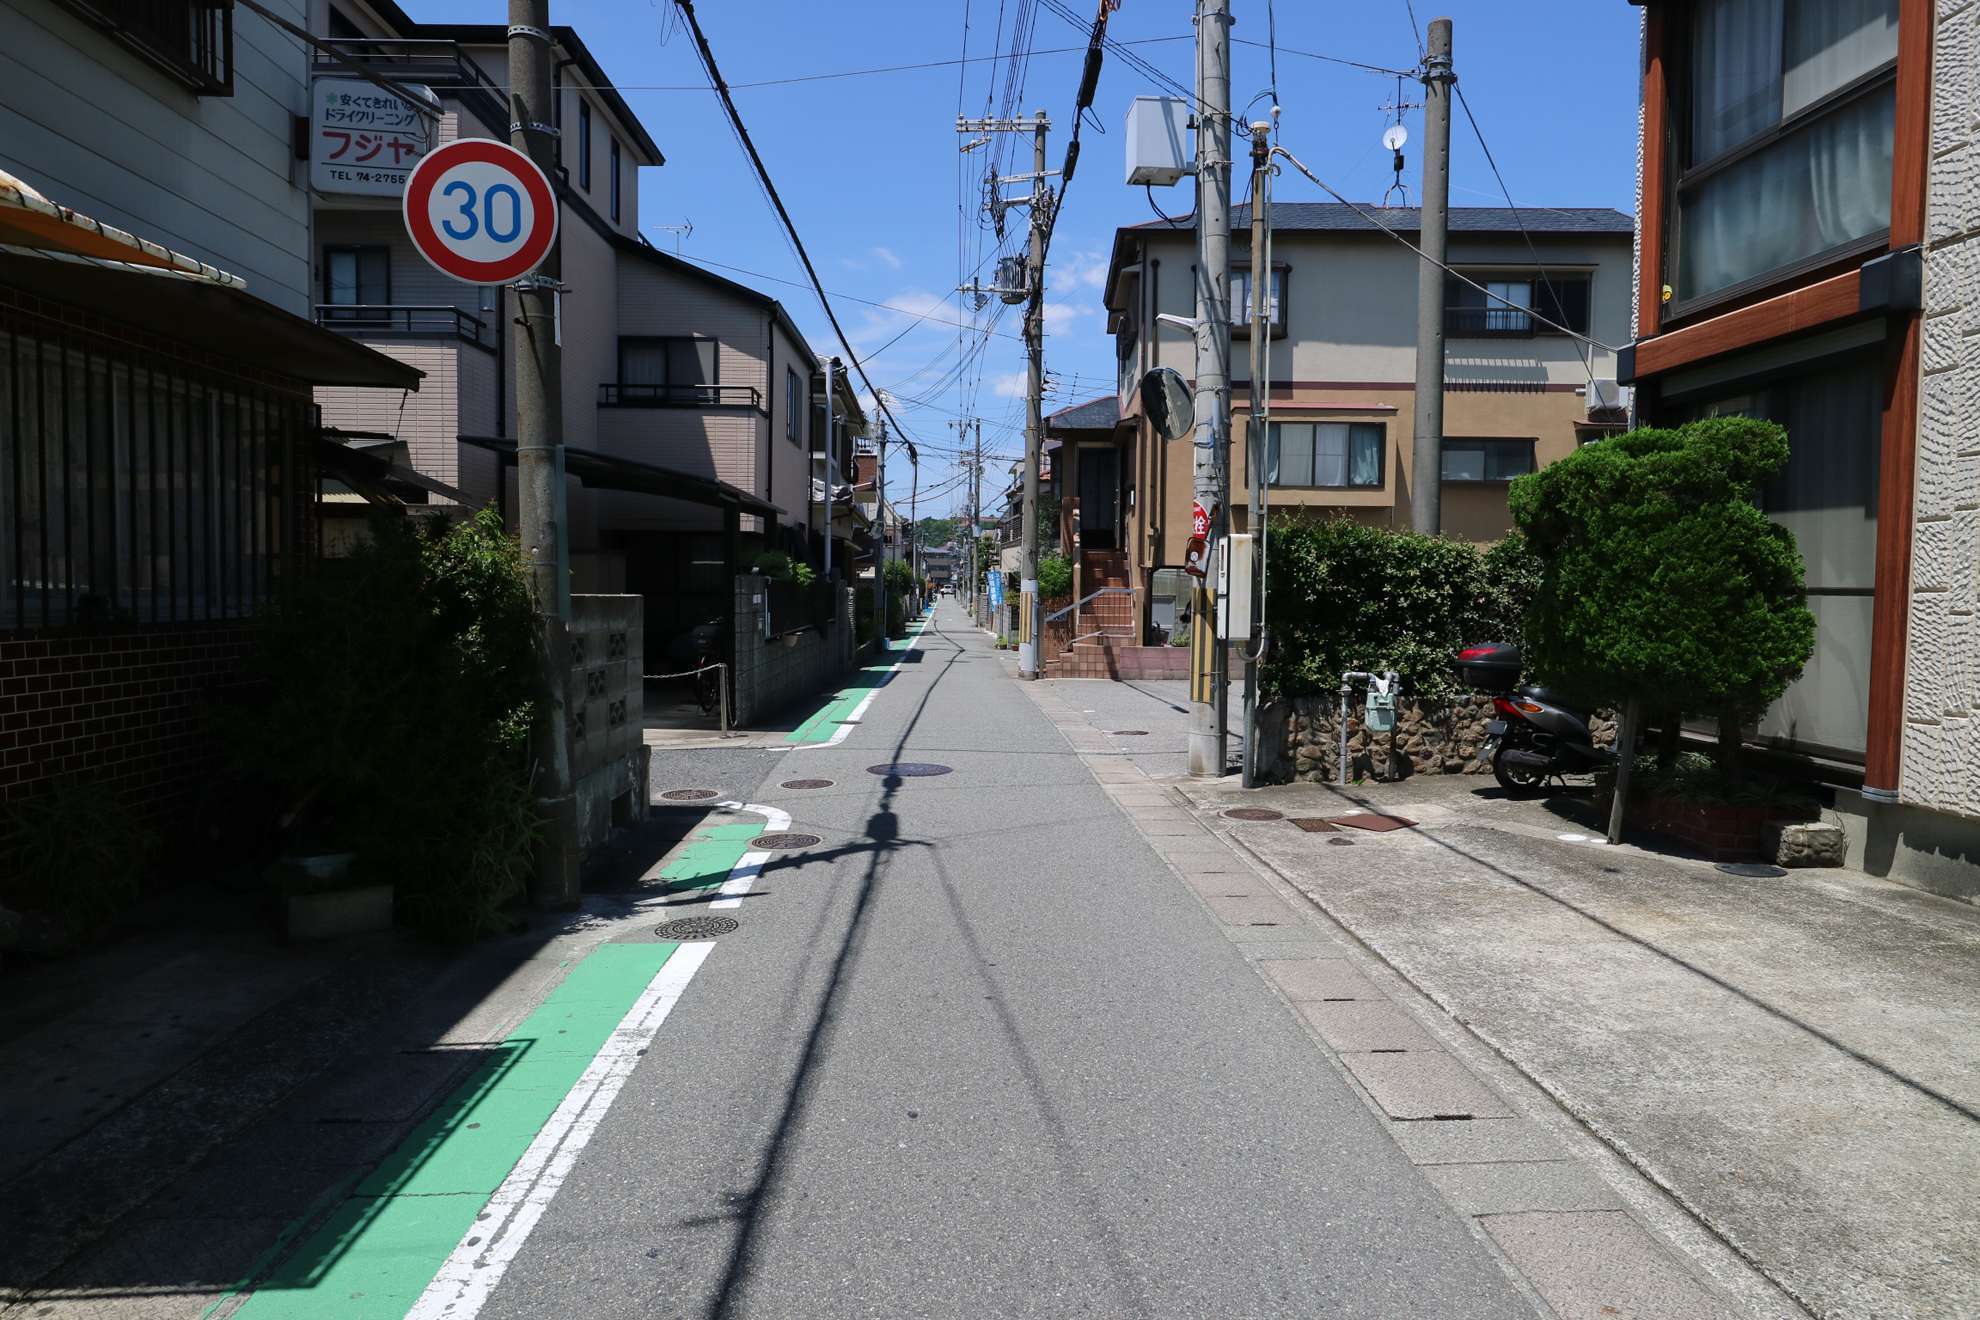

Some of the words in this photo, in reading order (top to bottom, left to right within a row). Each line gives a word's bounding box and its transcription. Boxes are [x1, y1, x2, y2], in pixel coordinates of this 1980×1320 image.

[325, 108, 416, 126] ドライクリーニング
[322, 131, 415, 164] フジヤ
[330, 169, 353, 181] TEL
[441, 180, 521, 243] 30
